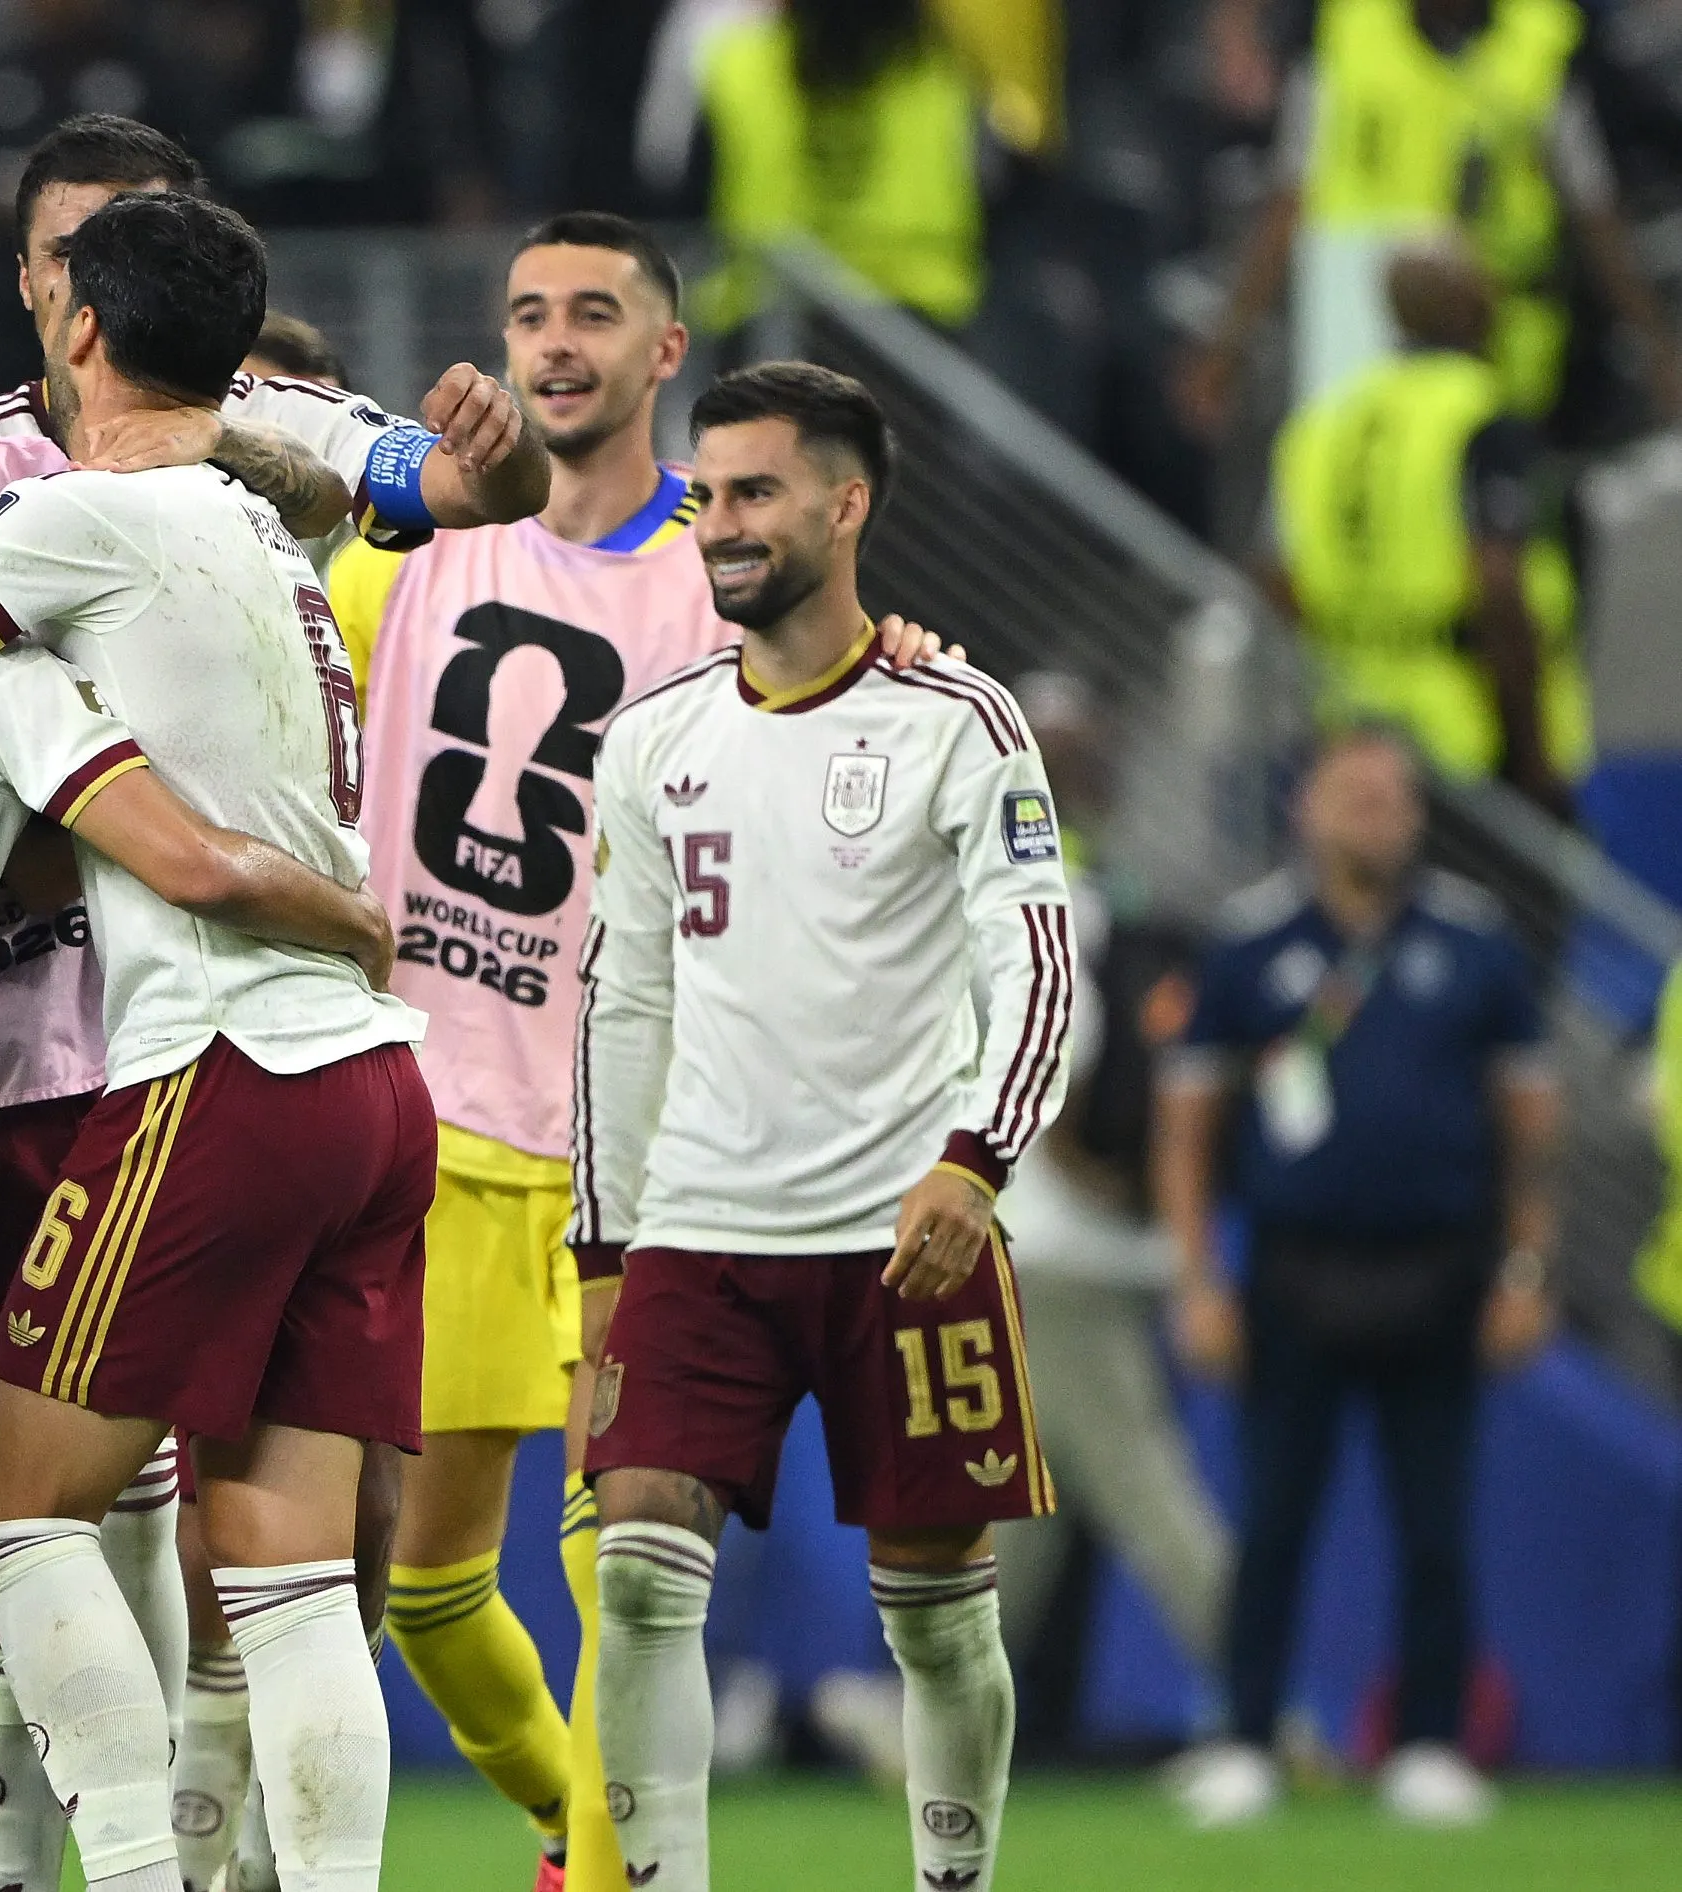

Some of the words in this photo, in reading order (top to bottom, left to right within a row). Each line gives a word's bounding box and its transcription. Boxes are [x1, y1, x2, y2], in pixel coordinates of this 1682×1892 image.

[369, 429, 401, 484] FOOTBAL
[455, 834, 523, 890] FIFA
[397, 924, 550, 1008] 2026
[497, 927, 559, 961] CUP
[21, 1178, 90, 1291] 6
[894, 1318, 1004, 1439] 15
